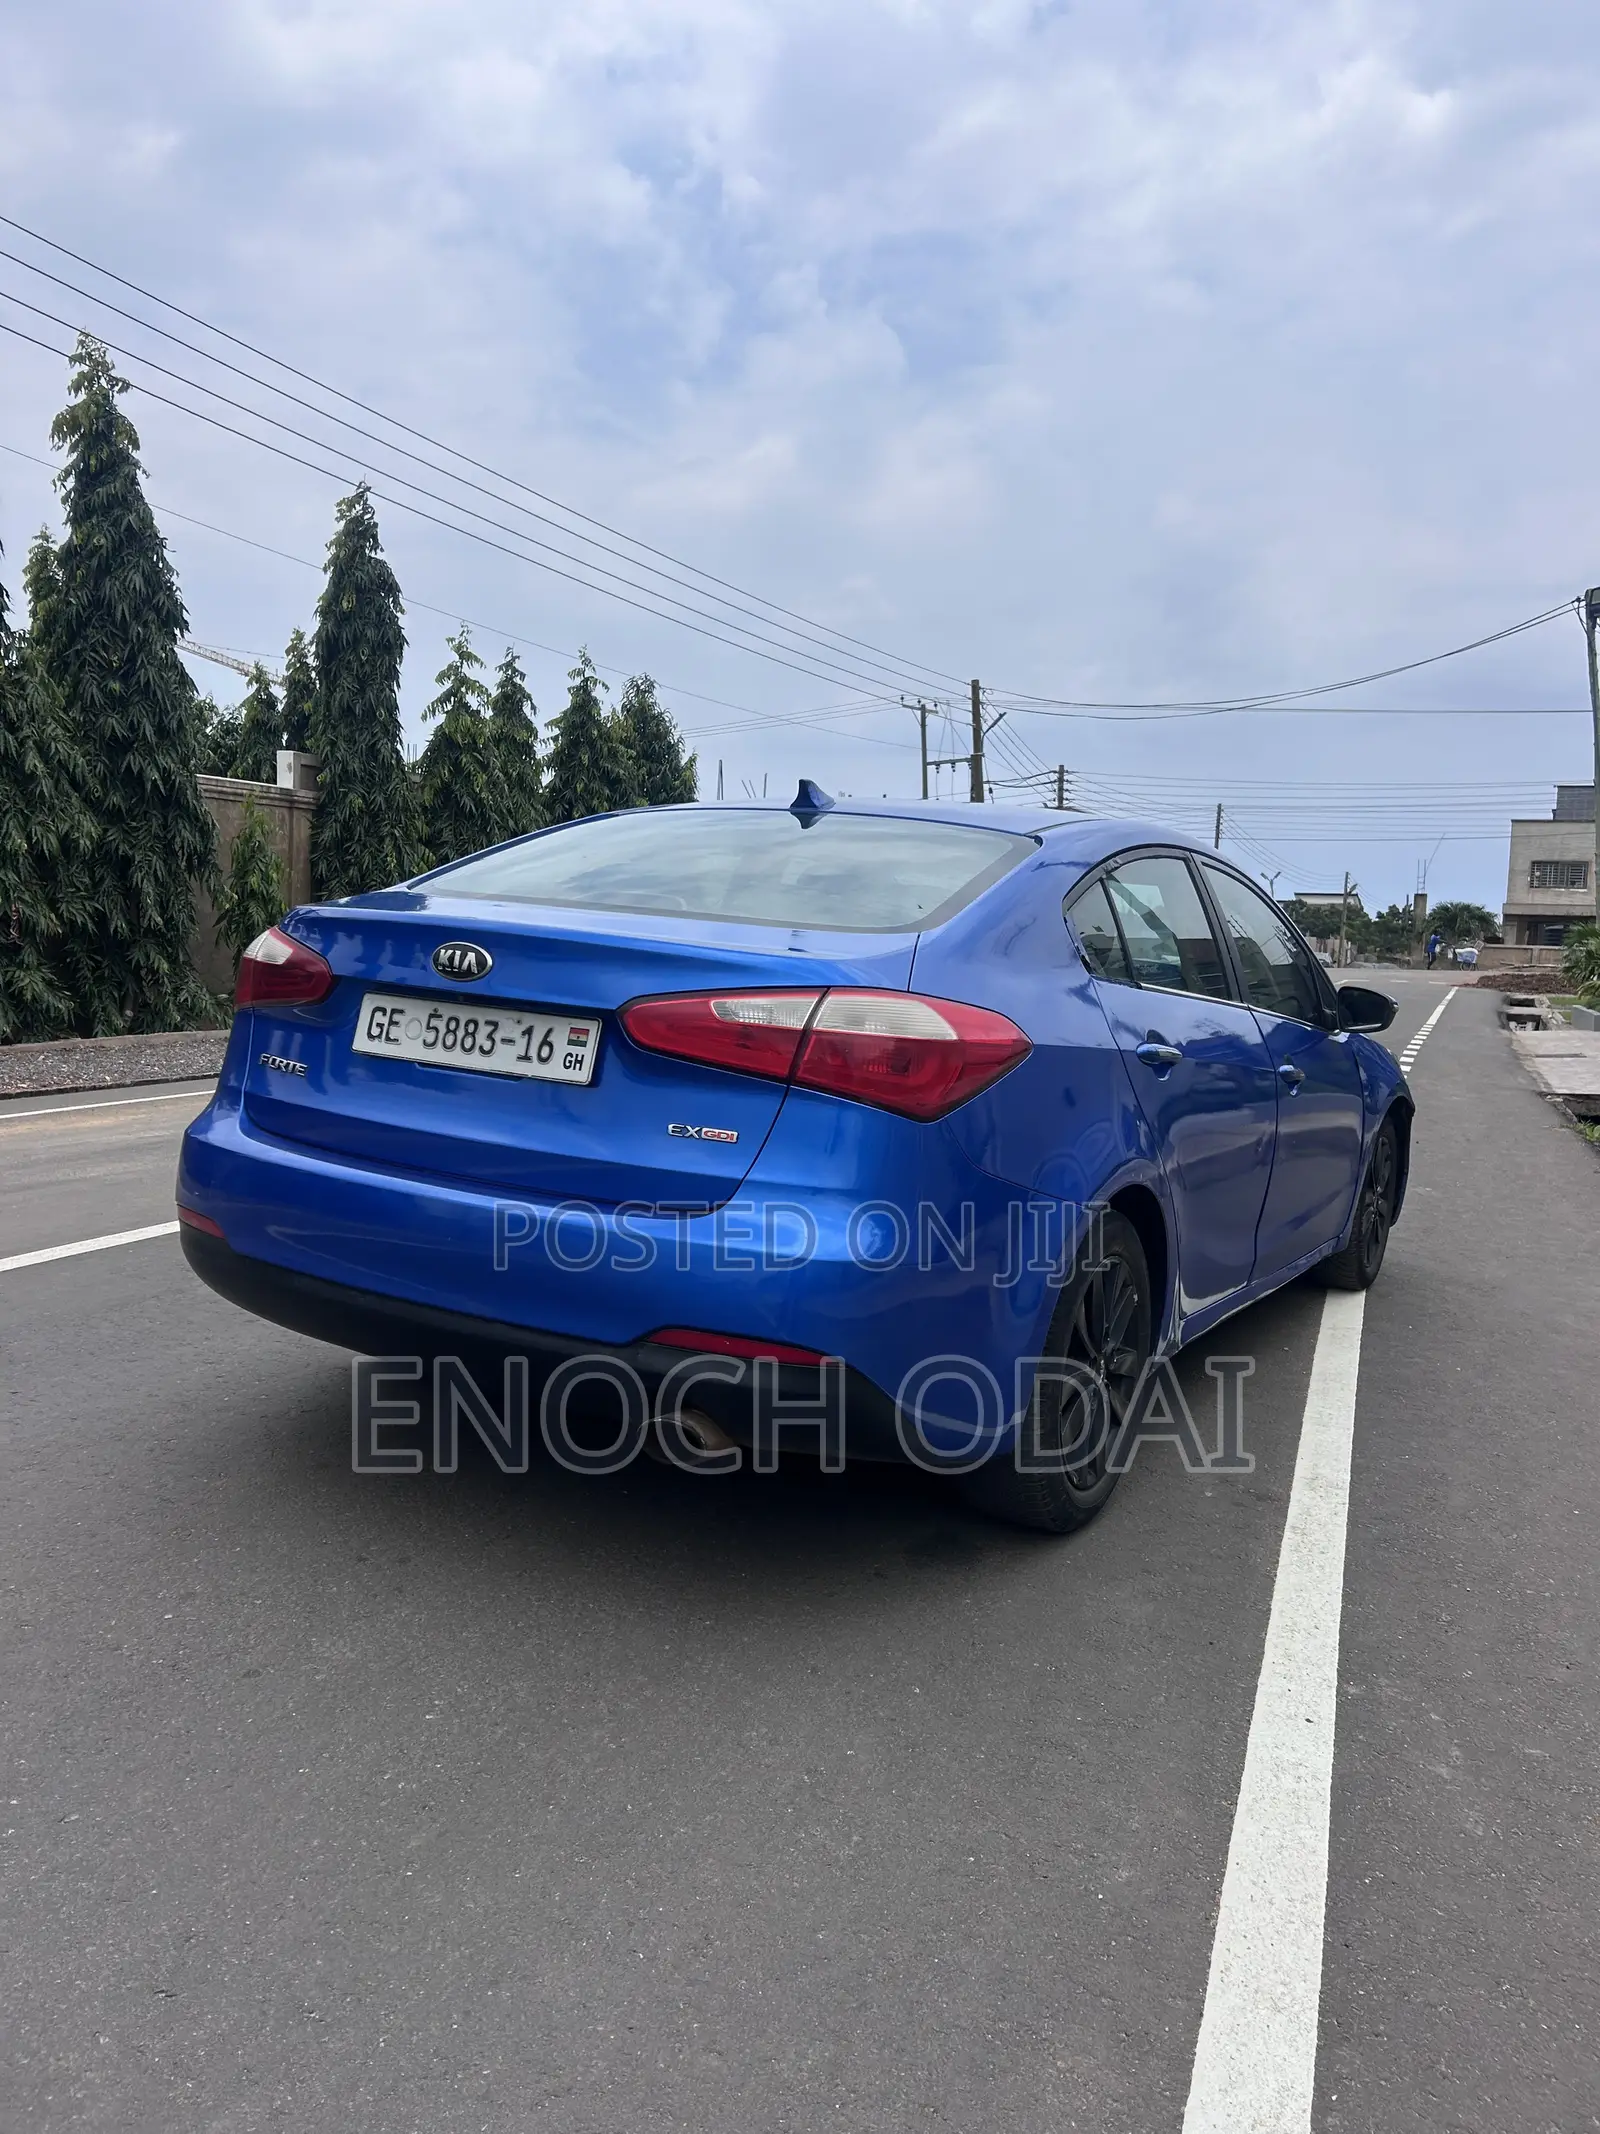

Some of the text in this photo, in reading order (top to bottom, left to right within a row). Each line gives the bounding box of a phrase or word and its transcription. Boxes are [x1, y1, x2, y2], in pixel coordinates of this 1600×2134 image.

[437, 949, 479, 974] KIA
[366, 1006, 555, 1064] GE 5883-16
[259, 1053, 308, 1076] FORTE
[562, 1052, 585, 1072] GH
